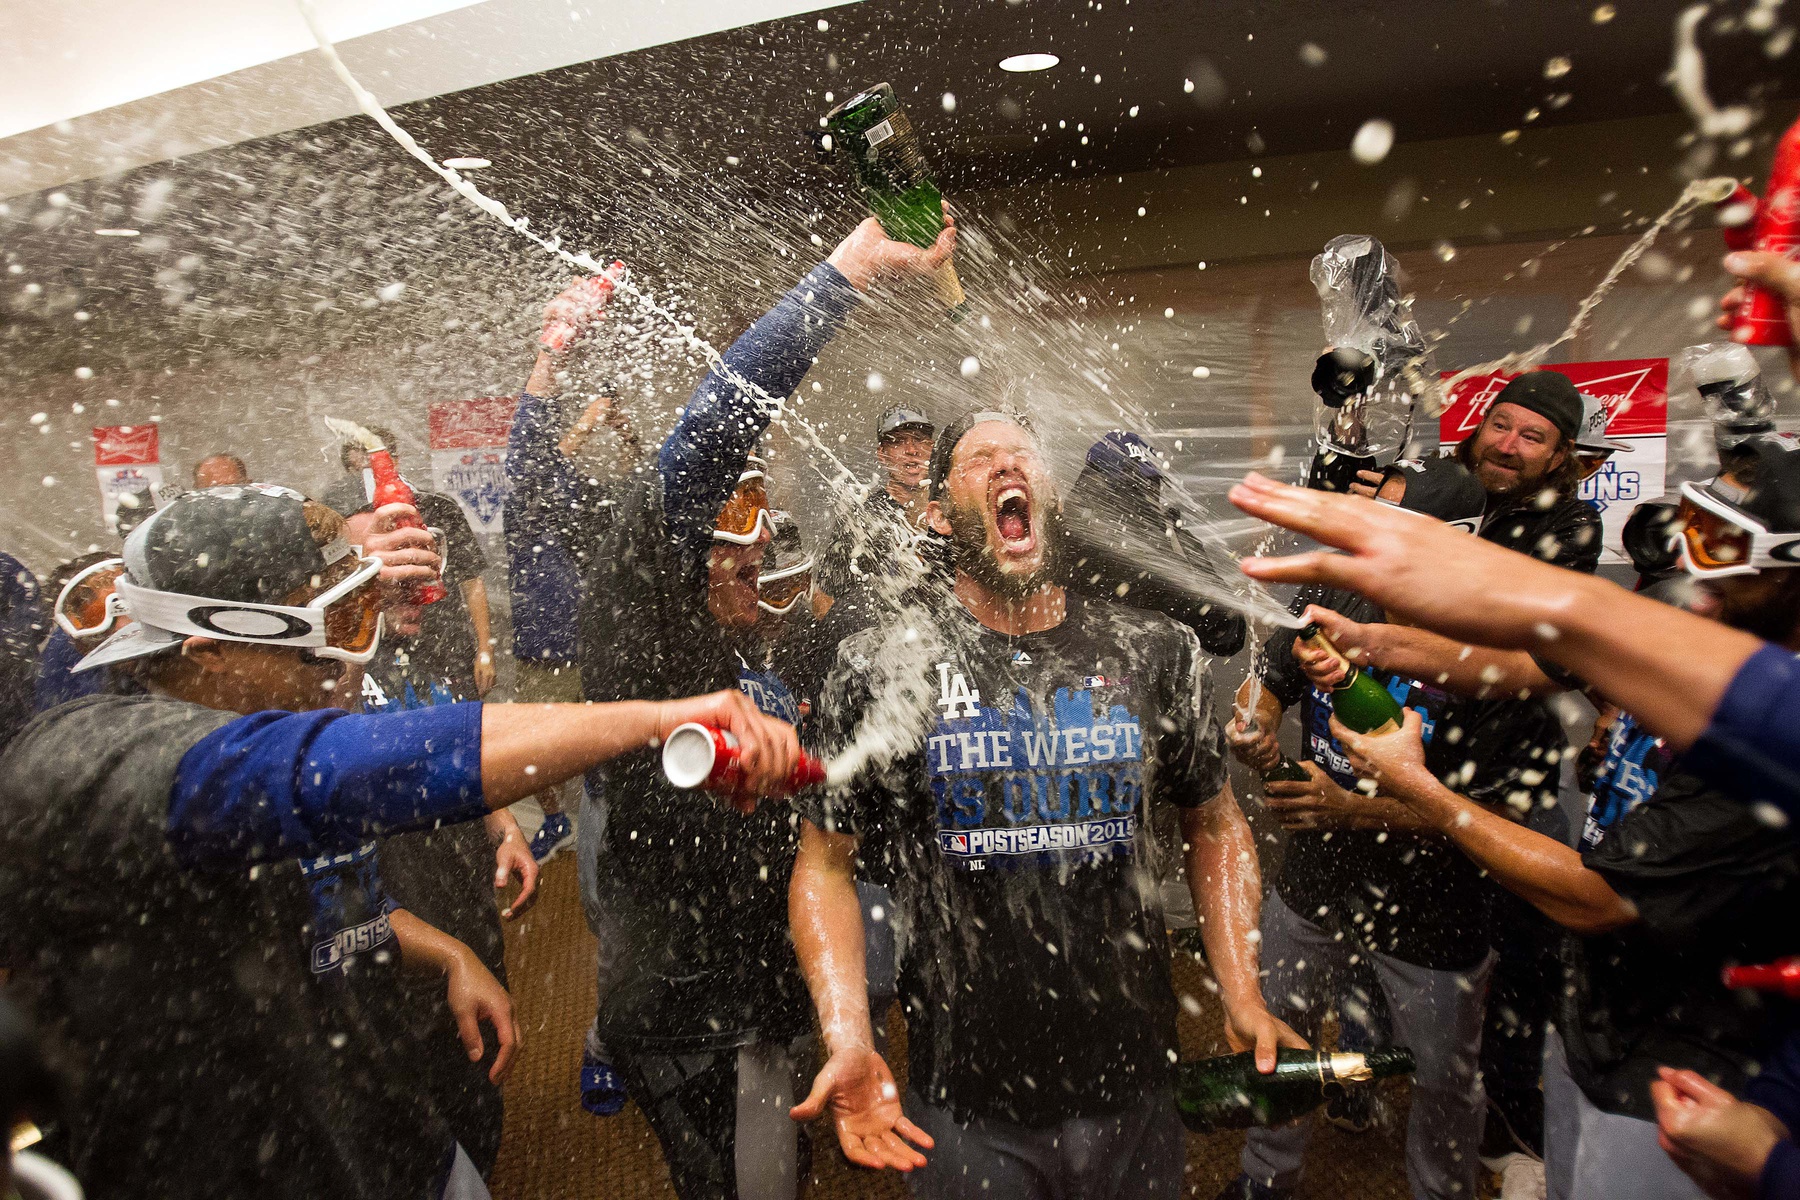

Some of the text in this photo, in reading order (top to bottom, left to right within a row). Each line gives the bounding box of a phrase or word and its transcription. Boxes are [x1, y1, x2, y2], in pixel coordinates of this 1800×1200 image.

[361, 672, 389, 706] A
[935, 662, 980, 720] LA
[929, 722, 1140, 773] THE WEST
[969, 825, 1089, 853] POSTSEASON
[969, 860, 985, 871] NL
